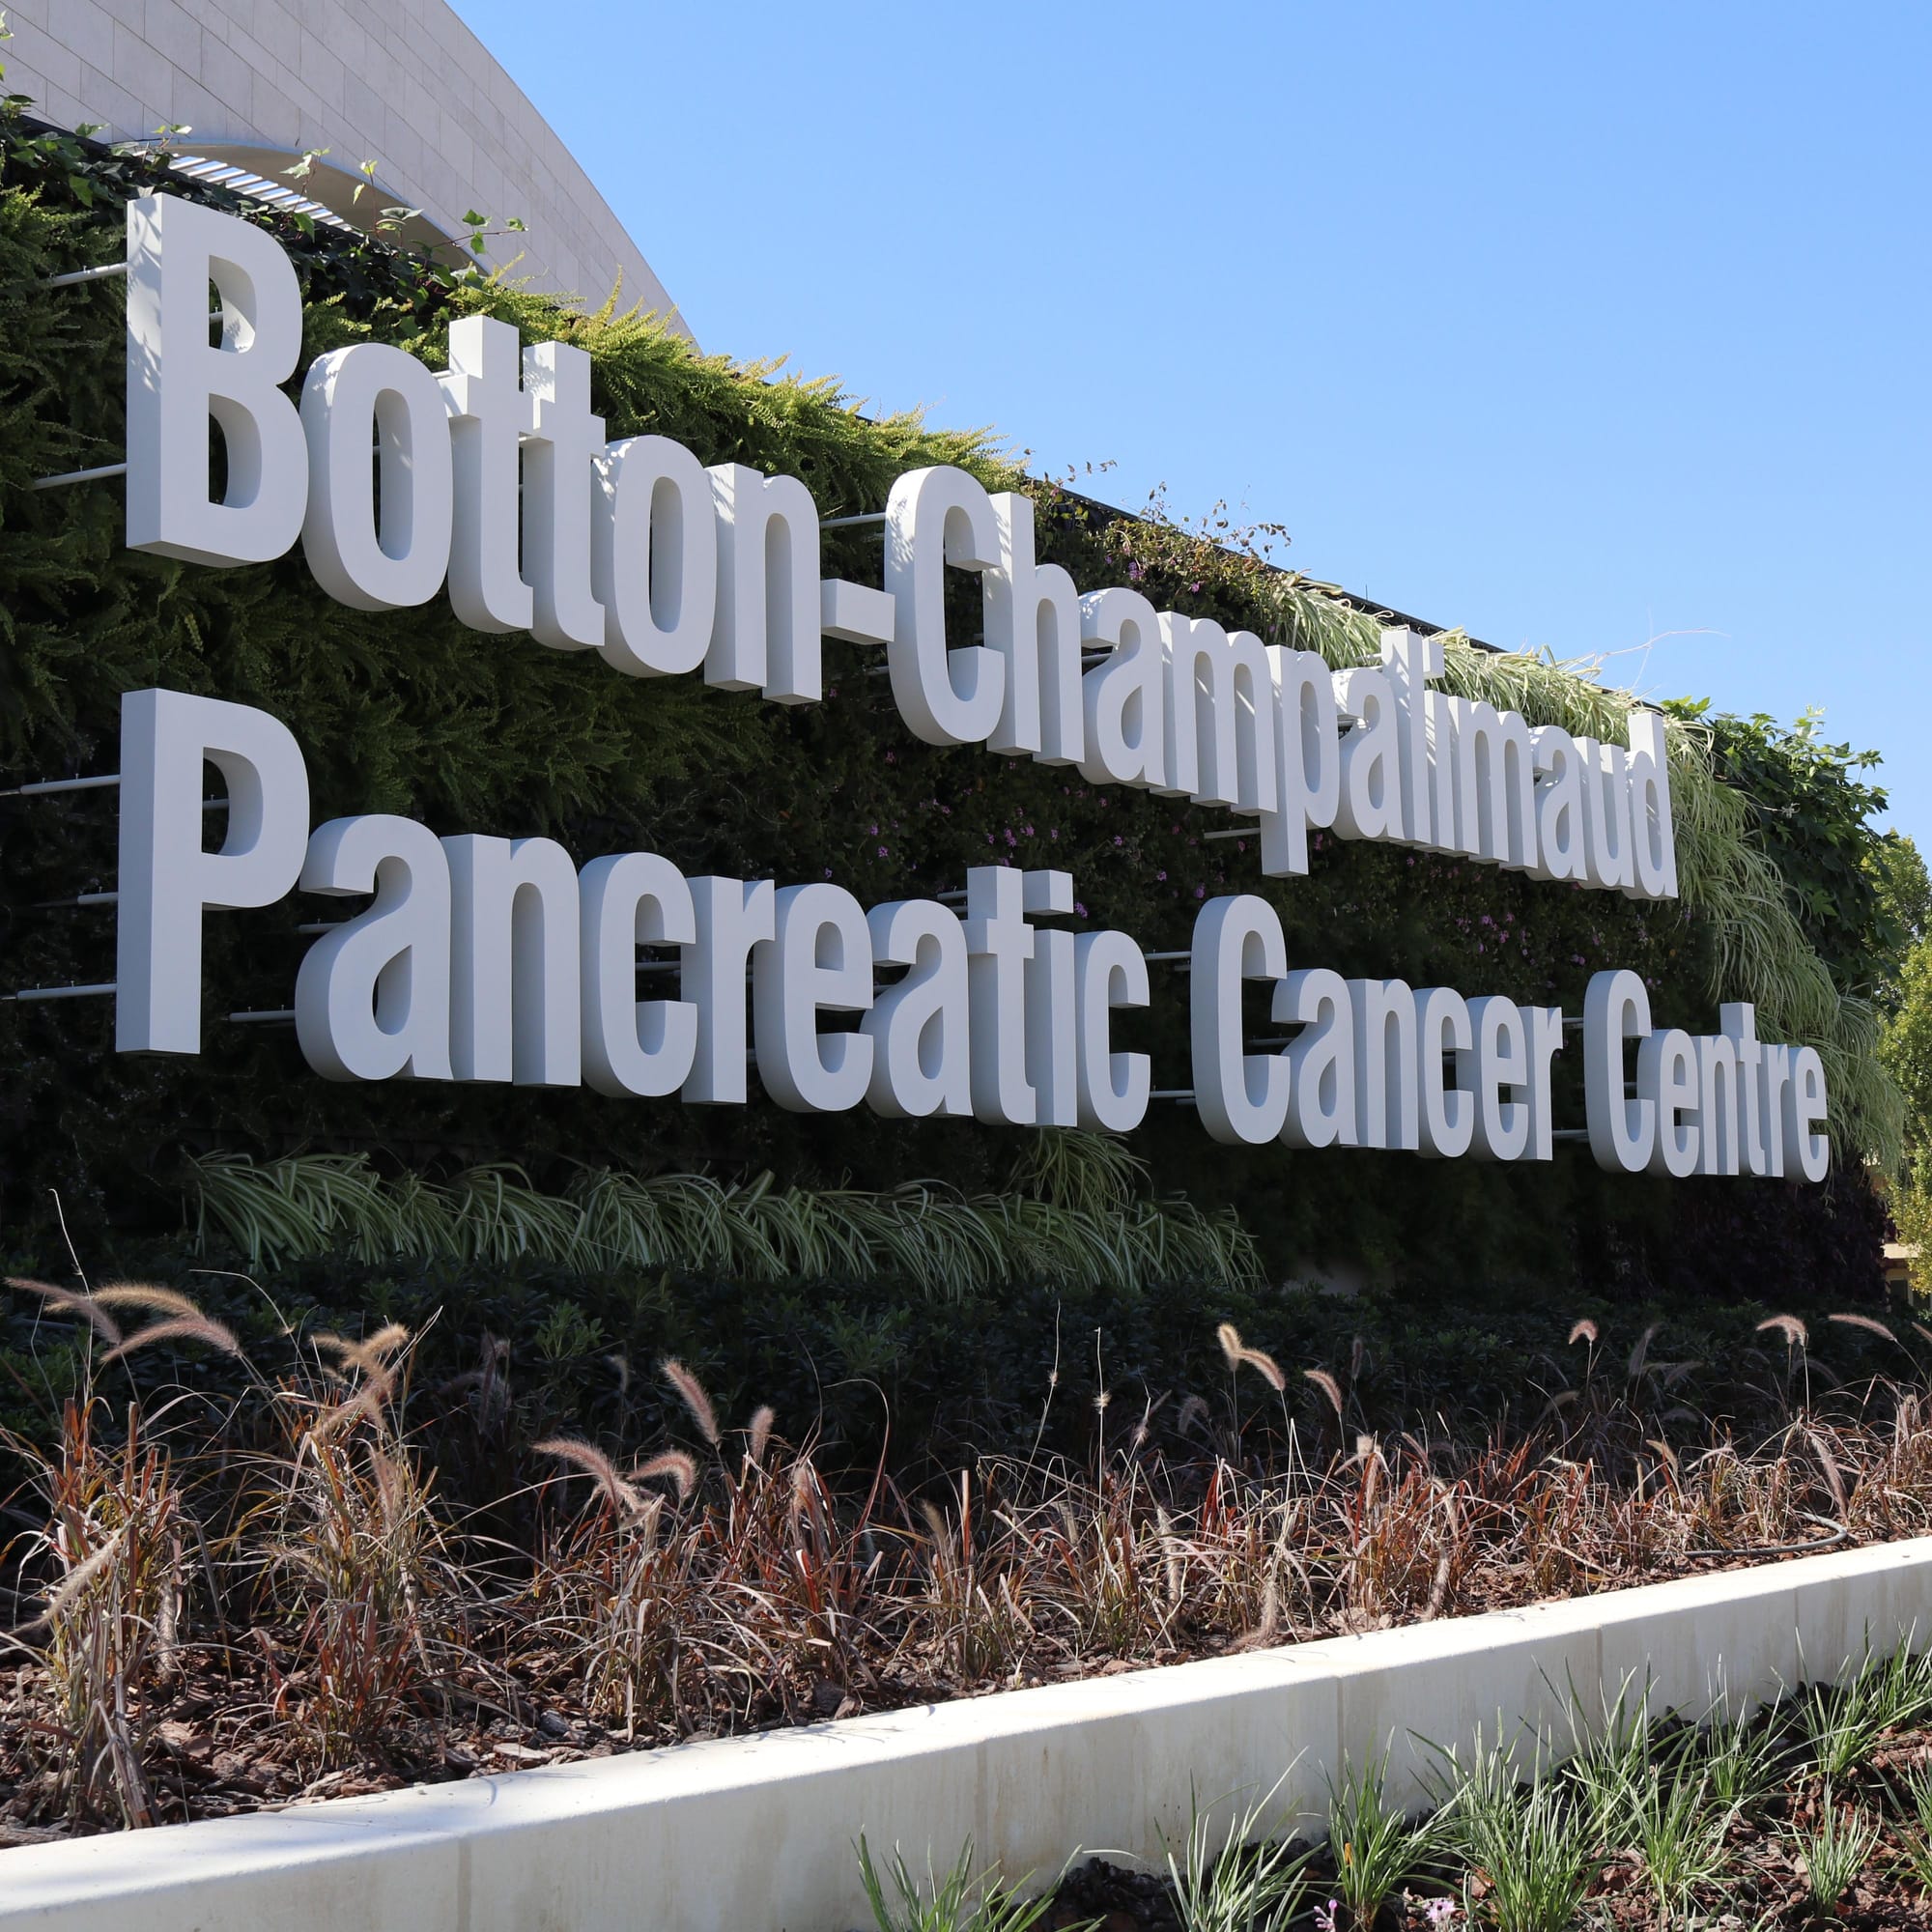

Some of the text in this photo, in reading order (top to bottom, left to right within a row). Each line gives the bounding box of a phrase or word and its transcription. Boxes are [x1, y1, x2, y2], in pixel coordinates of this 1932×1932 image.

[127, 192, 1678, 900] Botton-Champalimaud
[116, 688, 1830, 1183] Pancreatic Cancer Centre
